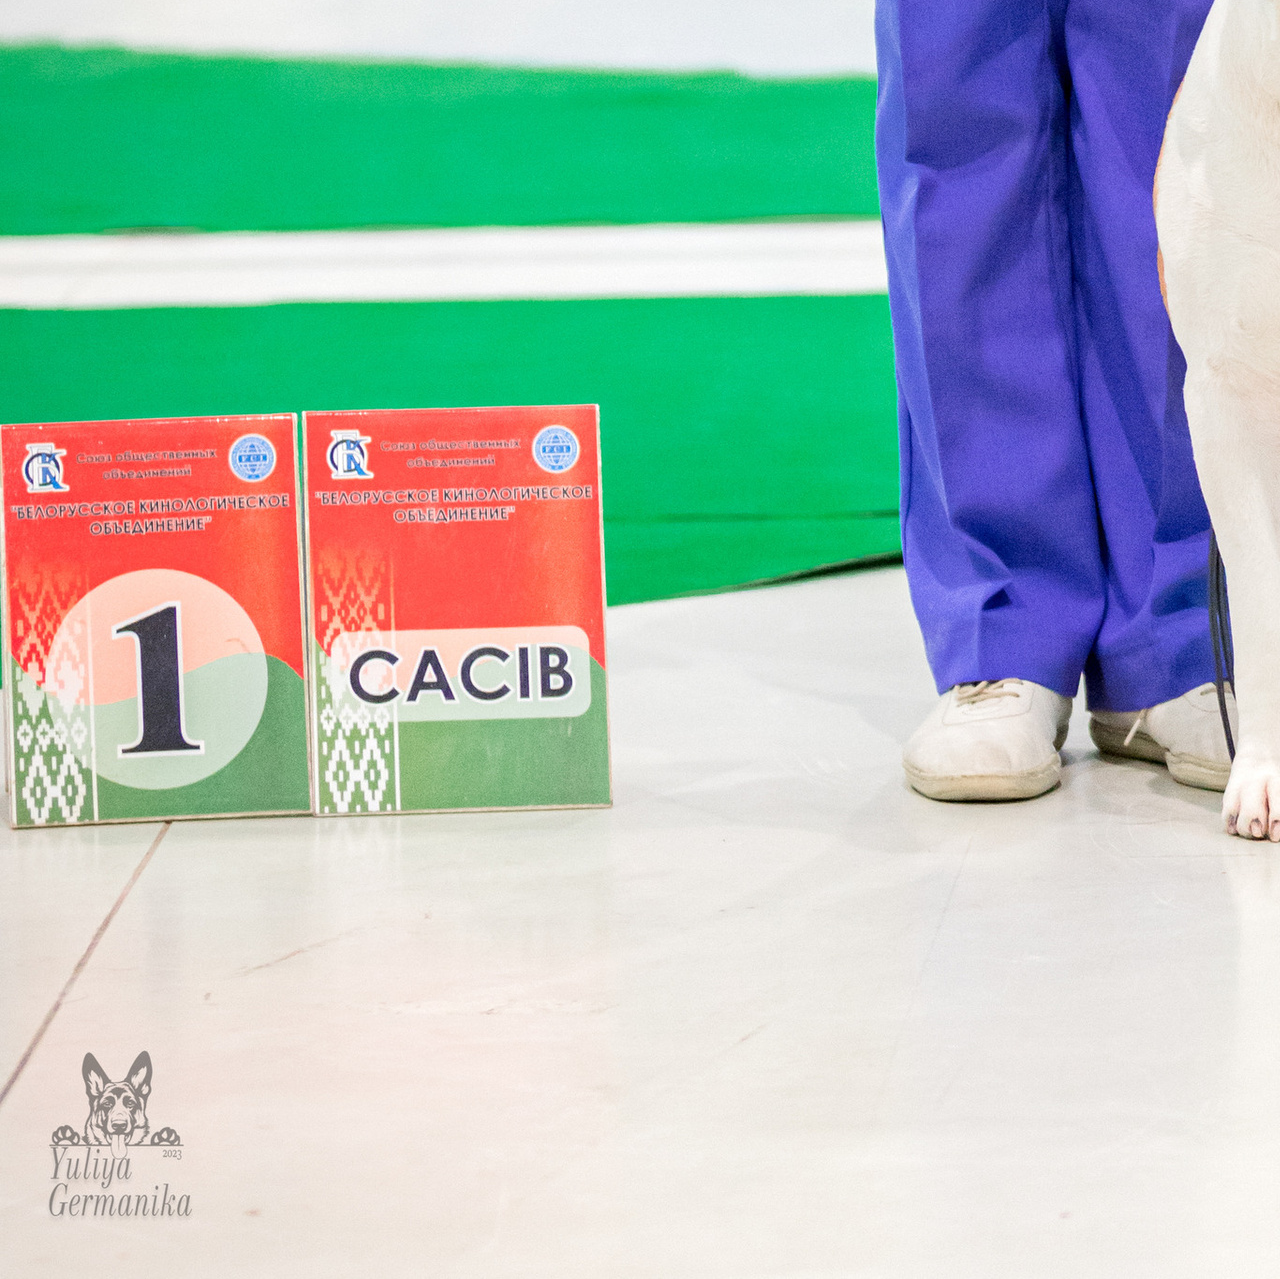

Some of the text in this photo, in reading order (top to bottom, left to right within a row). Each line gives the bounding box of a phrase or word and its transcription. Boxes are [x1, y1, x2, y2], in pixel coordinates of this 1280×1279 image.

[315, 485, 592, 506] "БЕЛОРУССКОЕ КИНОЛОГИЧЕСКОЕ
[11, 495, 289, 519] "БЕЛОРУССКОЕ КИНОЛОГИЧЕСКОЕ
[393, 506, 516, 523] ОБЪЕДИНЕНИЕ"
[90, 516, 212, 535] ОБЪЕДИНЕНИЕ"
[113, 602, 204, 757] 1
[348, 646, 574, 704] CACIB
